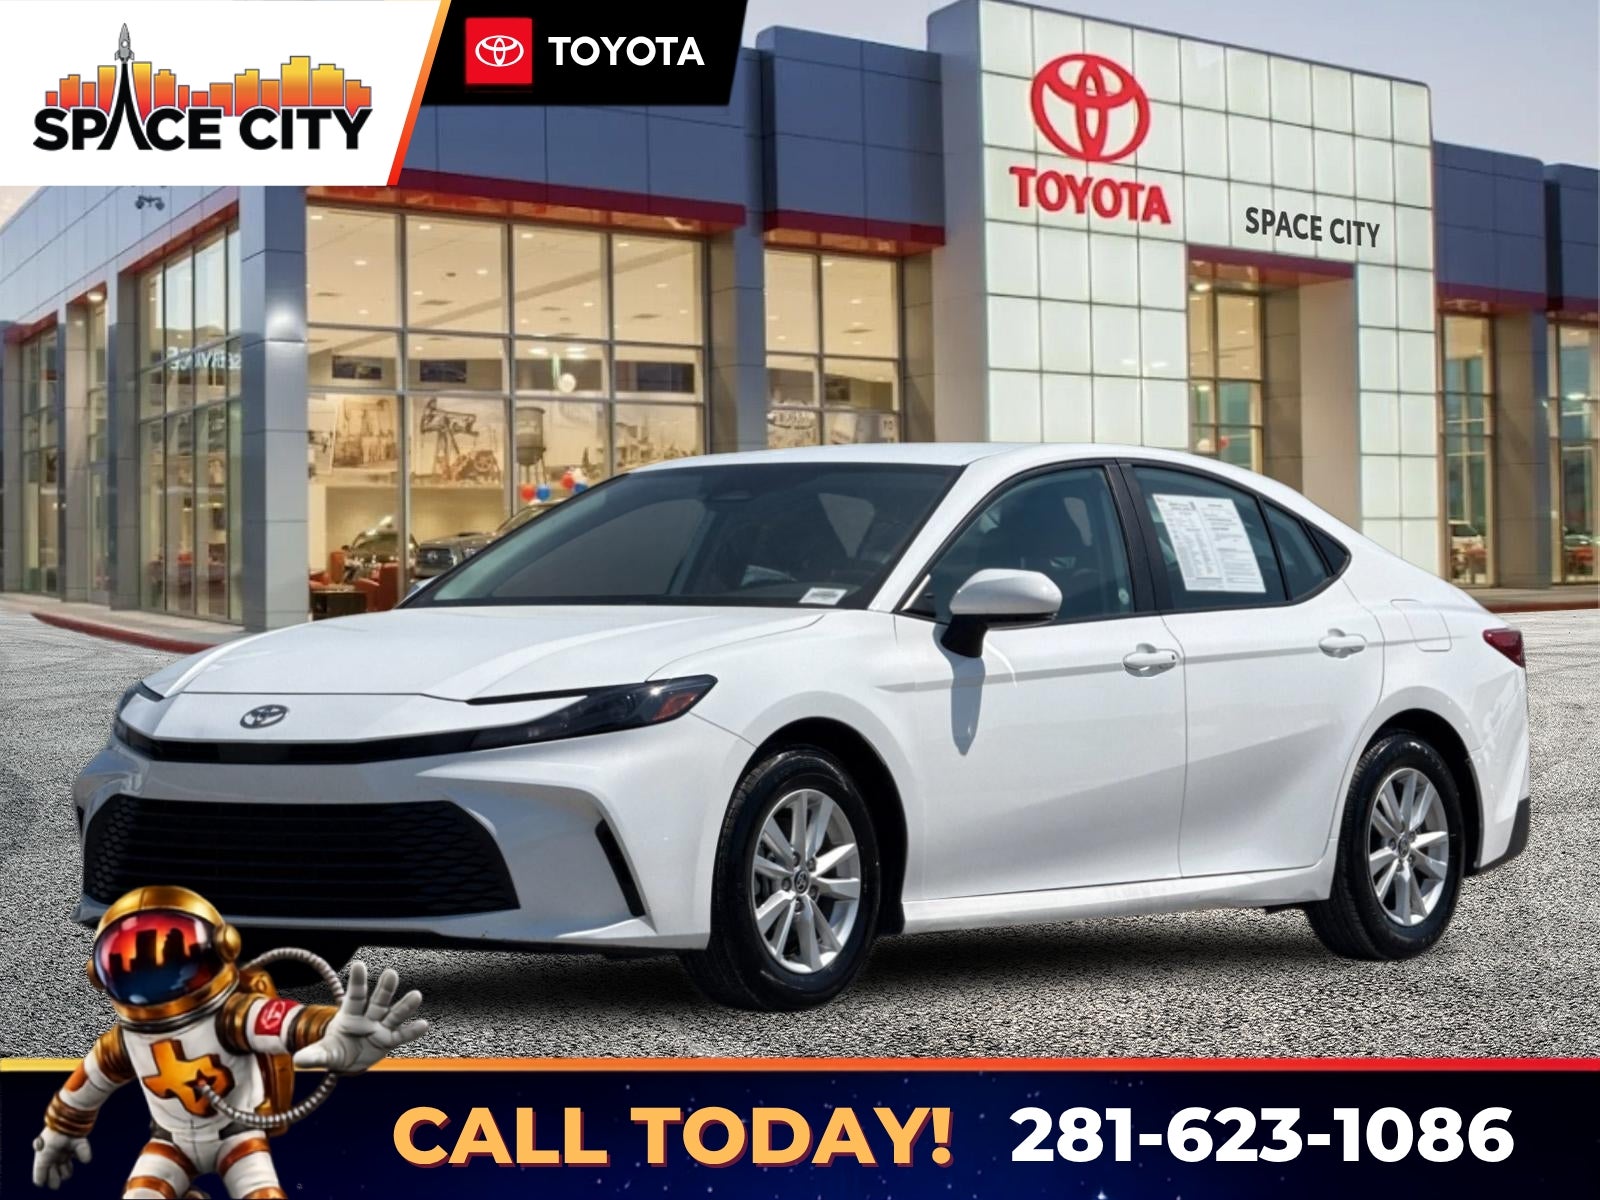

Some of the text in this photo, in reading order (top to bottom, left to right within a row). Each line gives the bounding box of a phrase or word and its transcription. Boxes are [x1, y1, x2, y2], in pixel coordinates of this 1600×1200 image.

[1009, 166, 1171, 225] TOYOTA
[1245, 206, 1381, 249] SPACE CITY
